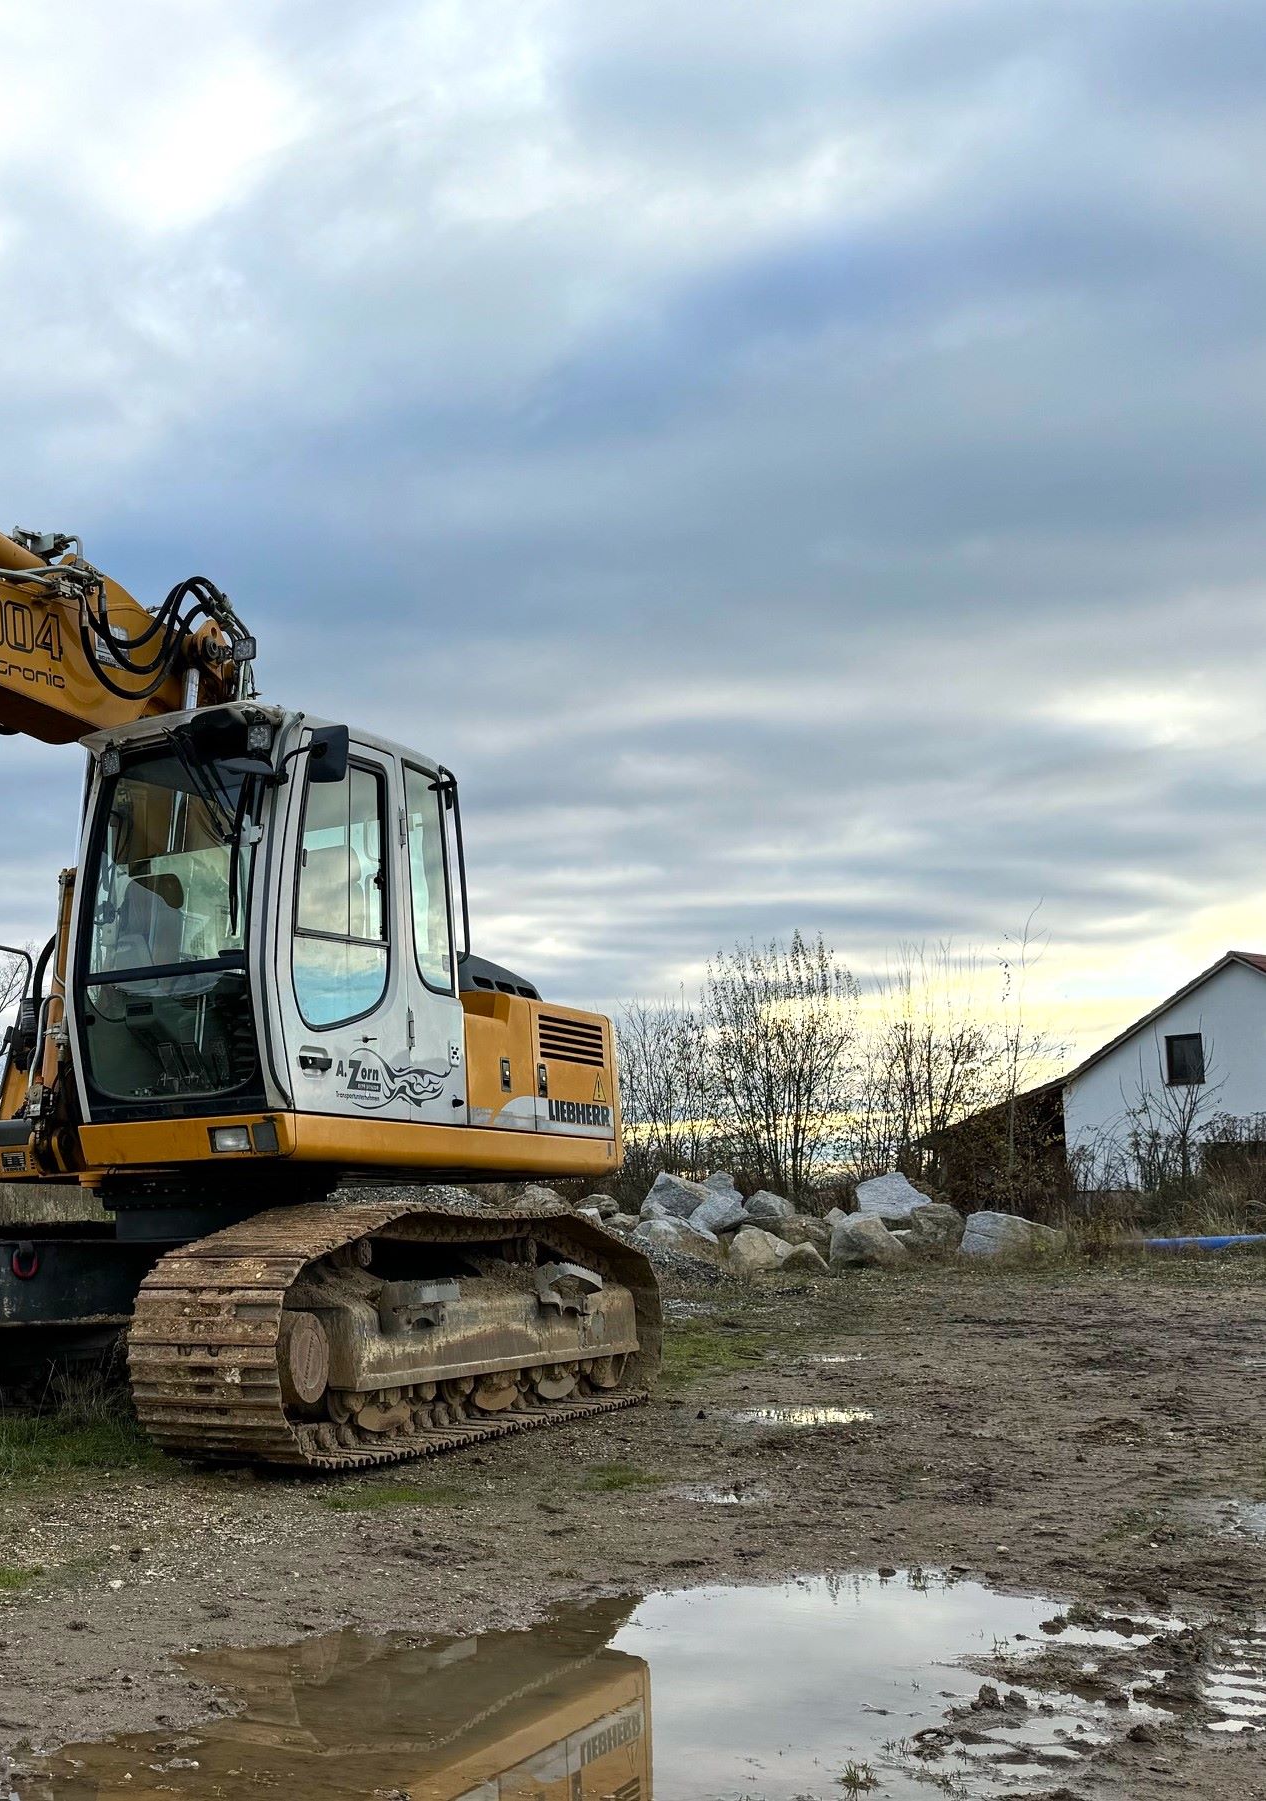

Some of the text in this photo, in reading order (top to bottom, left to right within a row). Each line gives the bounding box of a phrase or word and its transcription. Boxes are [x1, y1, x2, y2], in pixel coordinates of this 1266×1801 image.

[335, 1059, 379, 1090] A. Zorn
[548, 1098, 610, 1127] LIEBHERR
